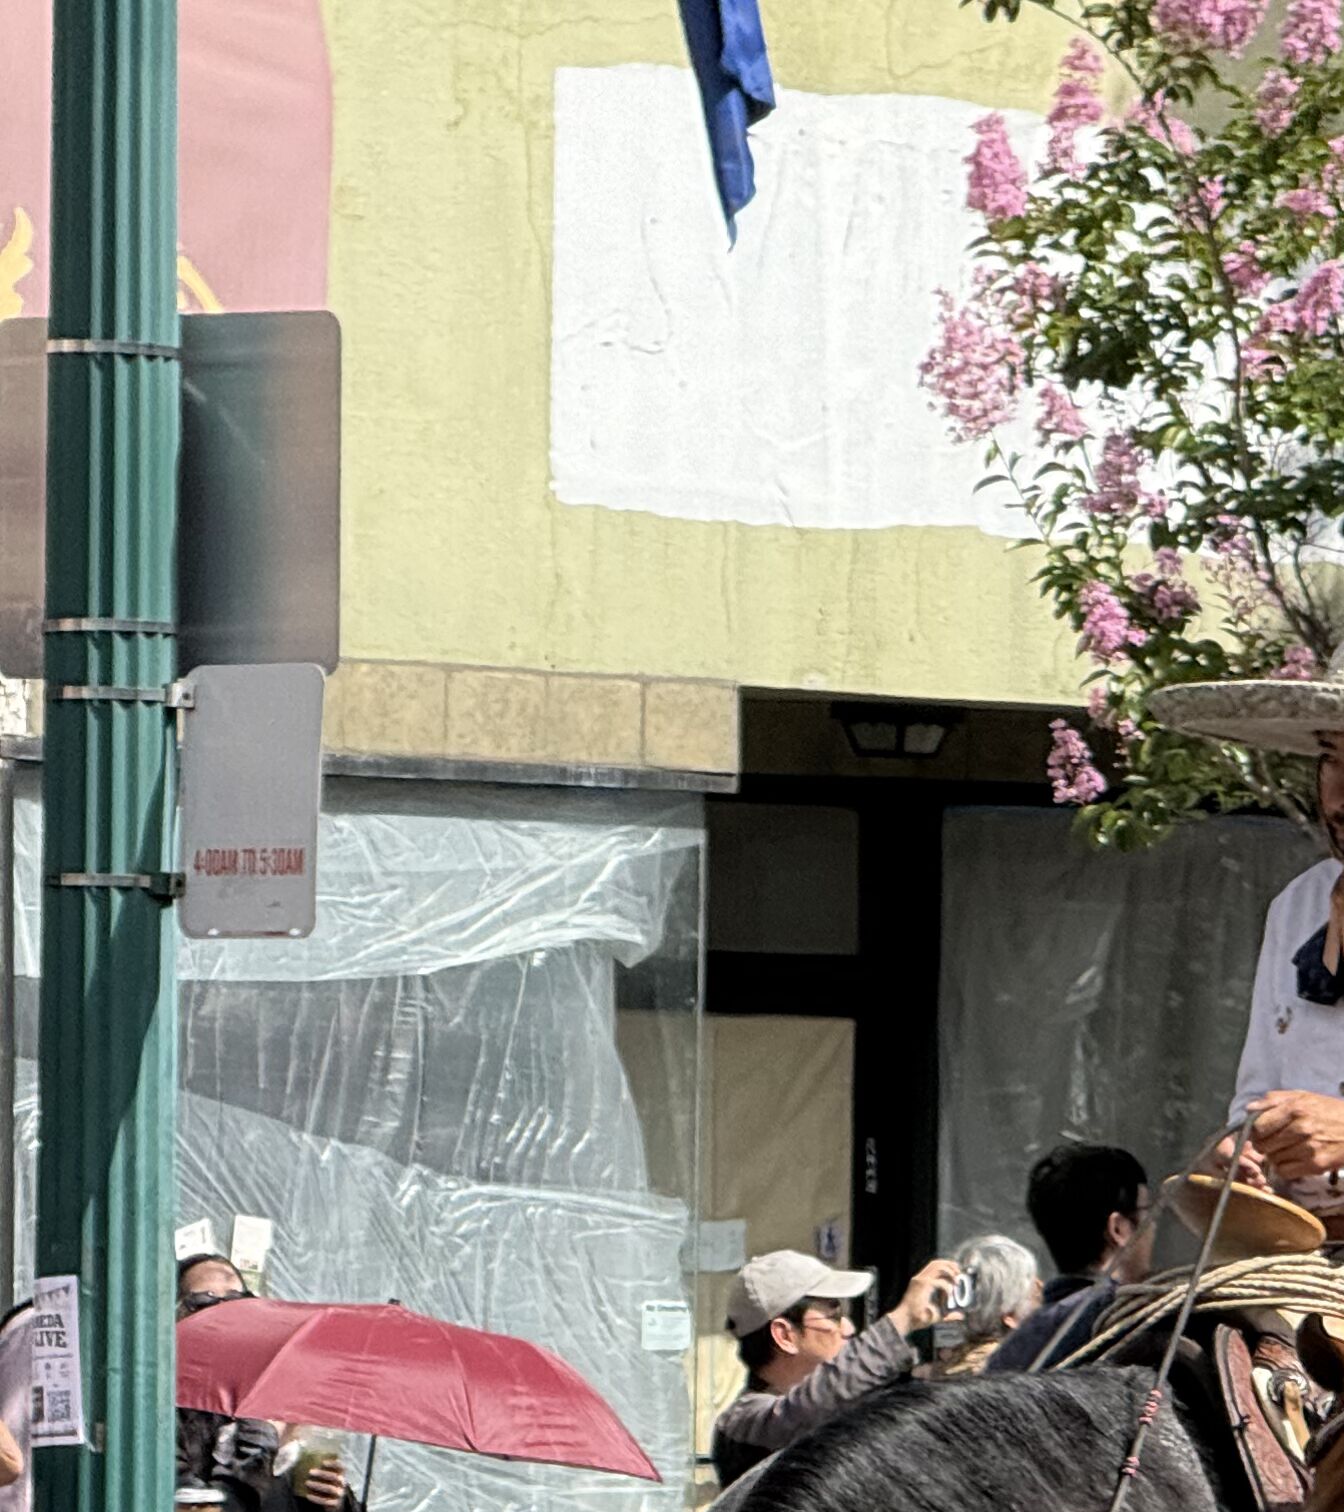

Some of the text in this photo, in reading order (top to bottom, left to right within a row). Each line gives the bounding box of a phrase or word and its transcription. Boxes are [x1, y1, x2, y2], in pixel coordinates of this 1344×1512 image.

[193, 847, 304, 876] 4:00AM TO 5:30AM
